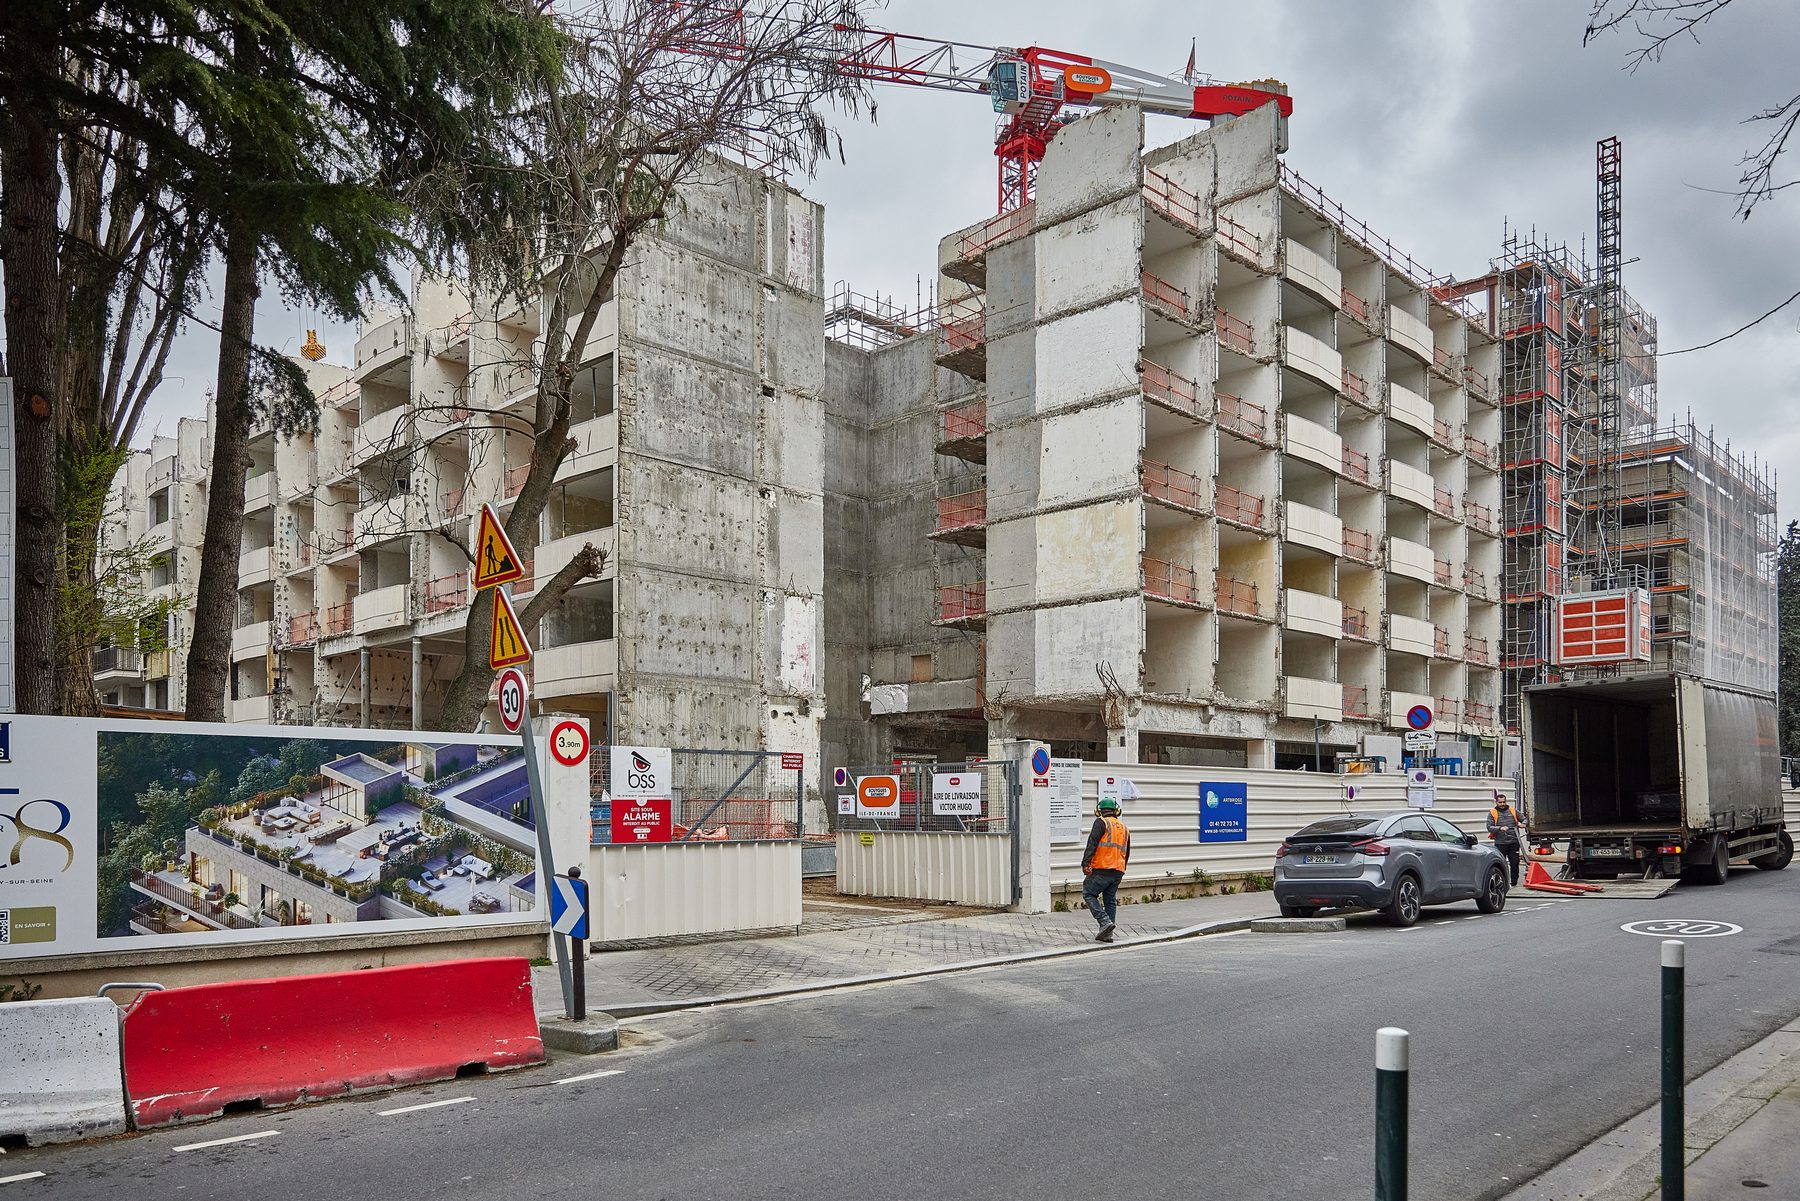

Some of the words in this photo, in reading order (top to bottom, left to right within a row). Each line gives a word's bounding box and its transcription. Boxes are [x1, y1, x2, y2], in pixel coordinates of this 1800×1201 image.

[503, 688, 519, 713] 30
[628, 769, 655, 788] bss
[944, 792, 951, 800] DE
[951, 792, 979, 800] LIVRAISON
[939, 803, 956, 811] VICTOR
[957, 803, 973, 811] HUGO
[623, 812, 660, 820] ALARME
[1647, 921, 1720, 934] 30
